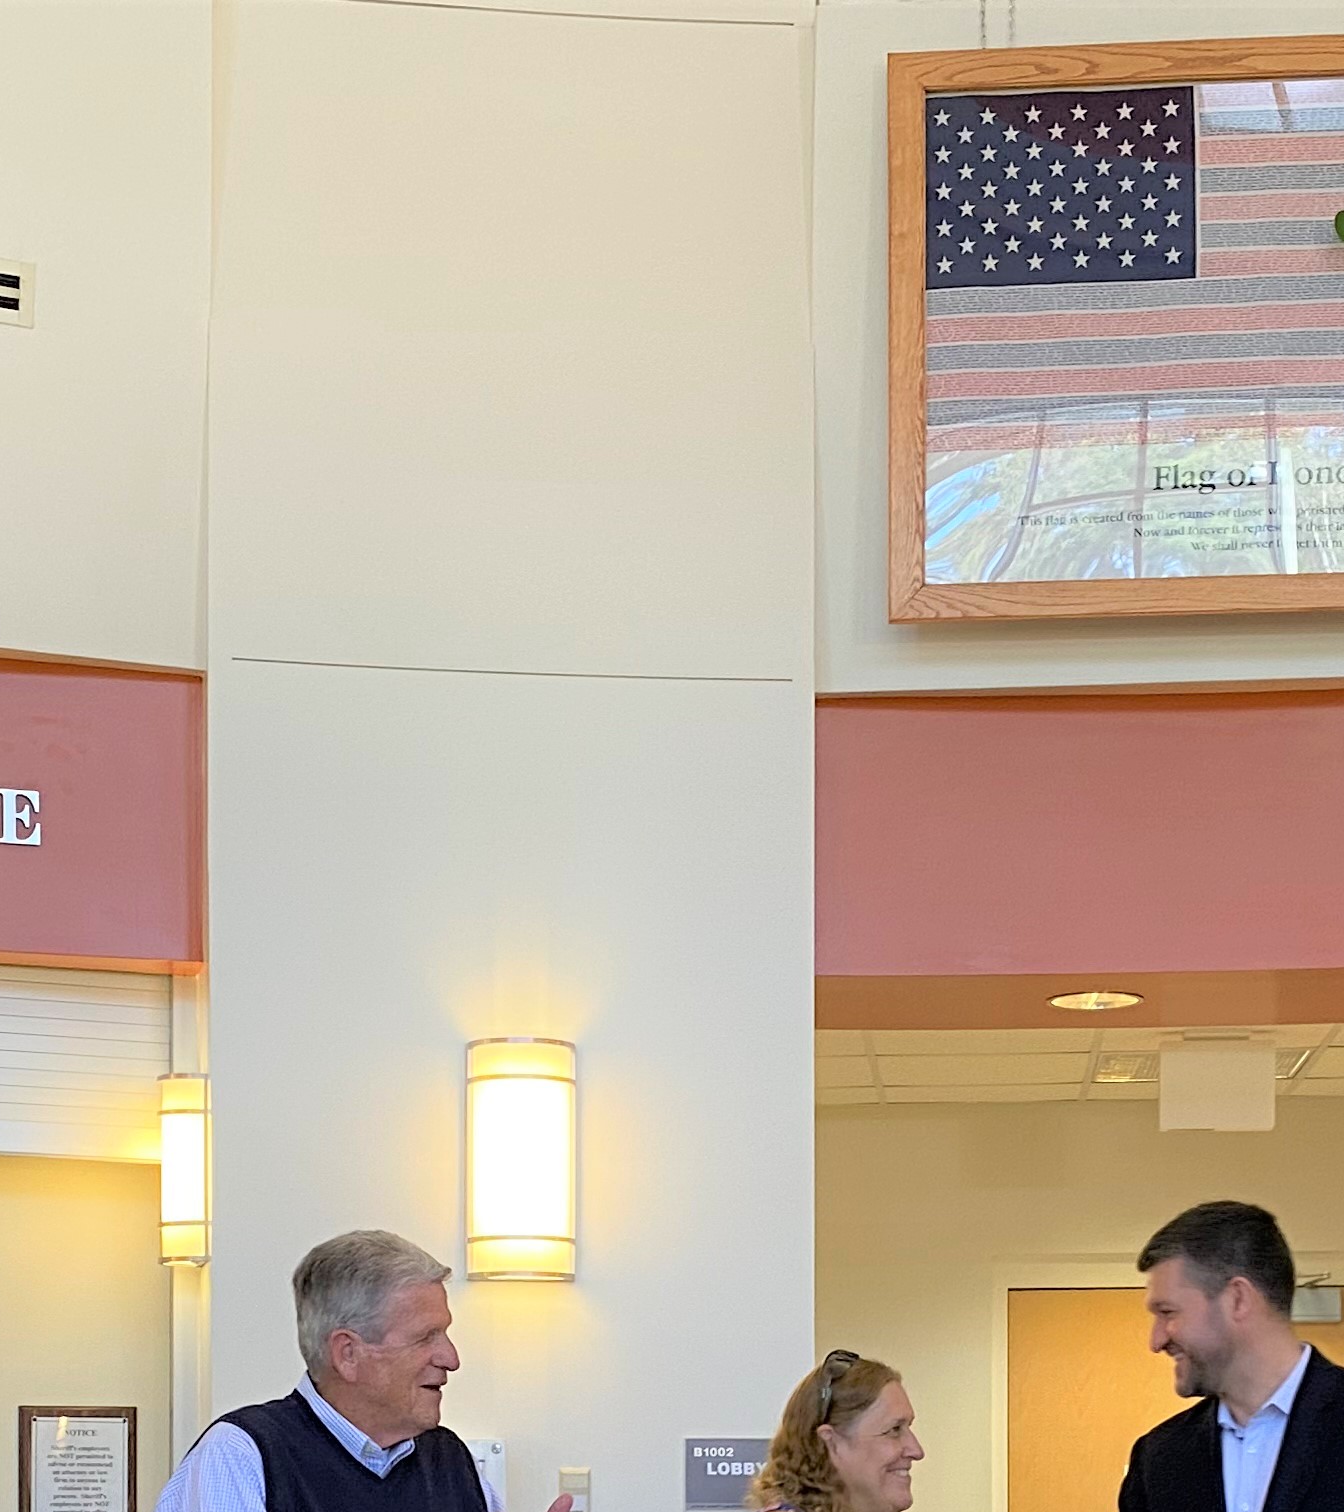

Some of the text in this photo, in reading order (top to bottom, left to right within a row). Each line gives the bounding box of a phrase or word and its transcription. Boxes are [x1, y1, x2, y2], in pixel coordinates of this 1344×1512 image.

[1153, 463, 1216, 494] Flag
[1082, 511, 1123, 524] created
[1127, 510, 1153, 522] from
[1177, 510, 1215, 520] names
[1233, 507, 1263, 518] those
[1133, 527, 1162, 538] Now
[1164, 525, 1186, 537] and
[1188, 524, 1229, 537] forever
[693, 1447, 734, 1457] B1002
[706, 1461, 768, 1476] LOBBY
